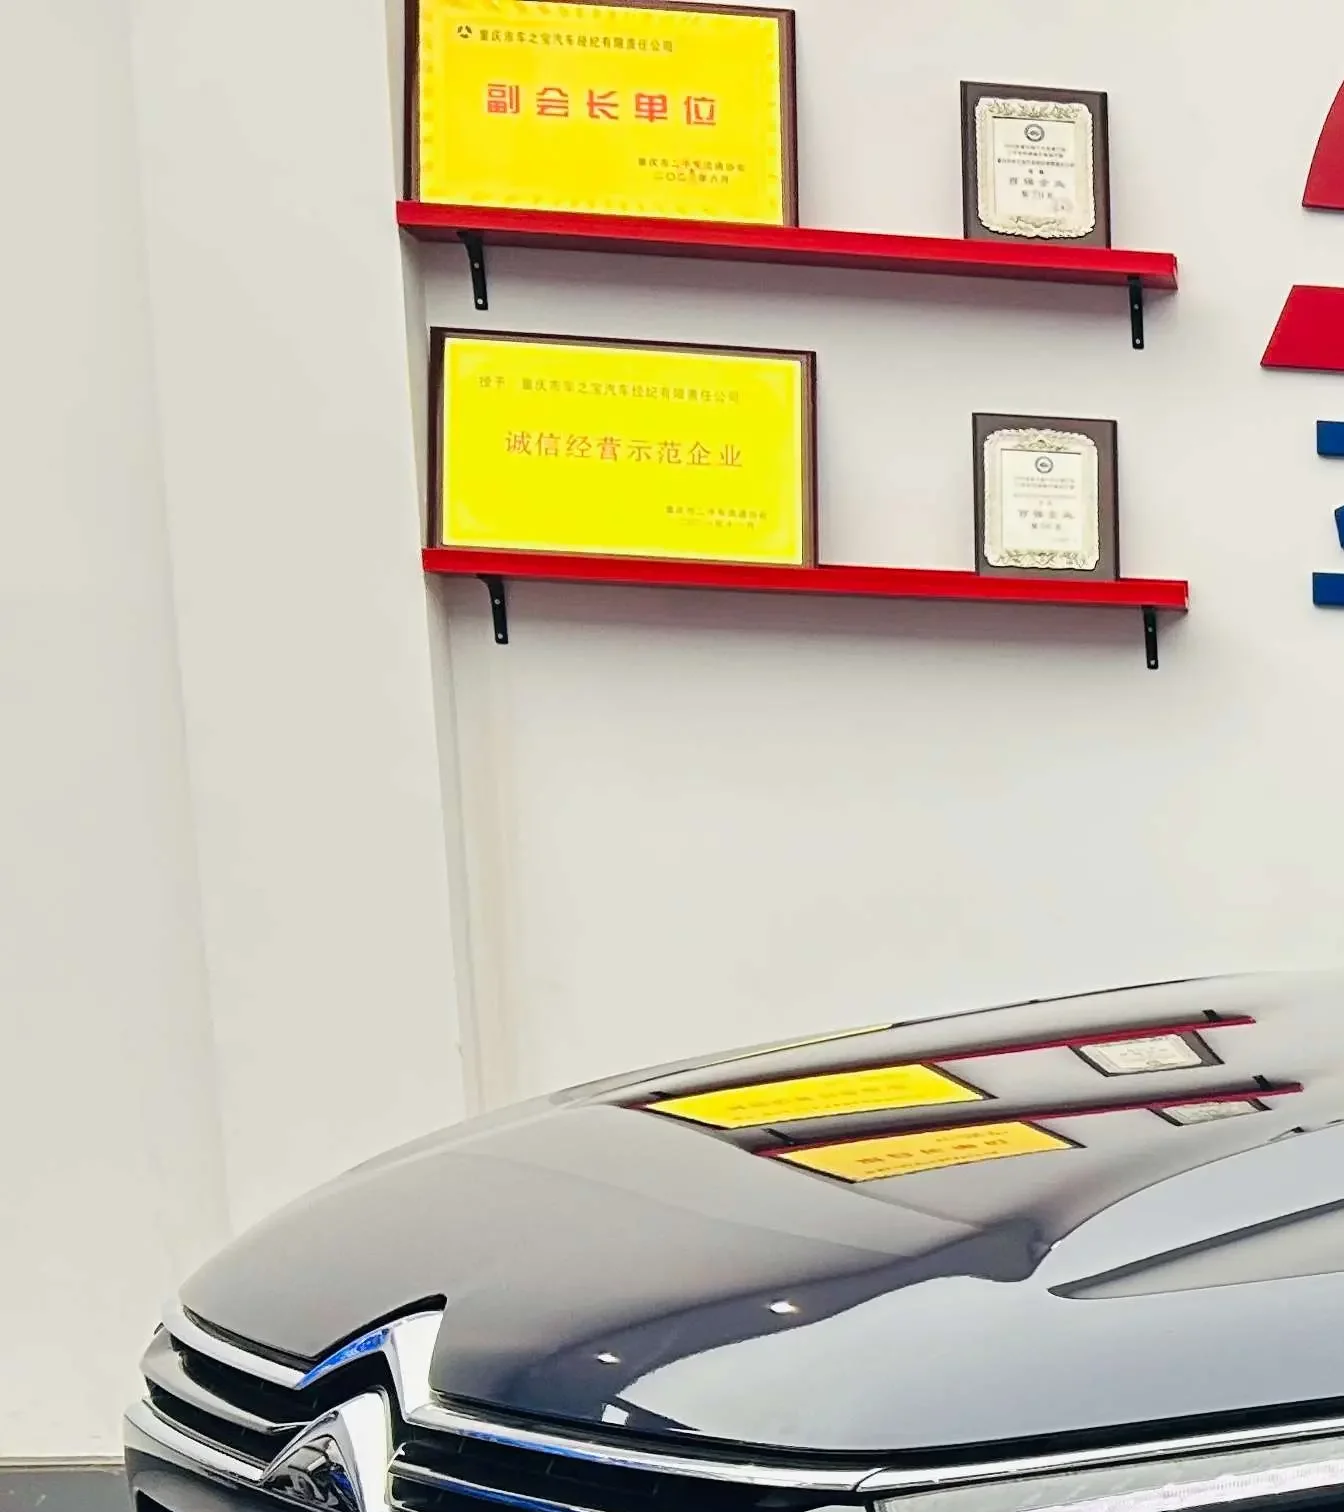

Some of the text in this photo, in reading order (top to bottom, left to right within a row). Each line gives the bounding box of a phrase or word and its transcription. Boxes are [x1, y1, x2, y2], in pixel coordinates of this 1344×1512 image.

[487, 83, 717, 127] 副会长单位
[505, 430, 743, 468] 诚信经营示范企业
